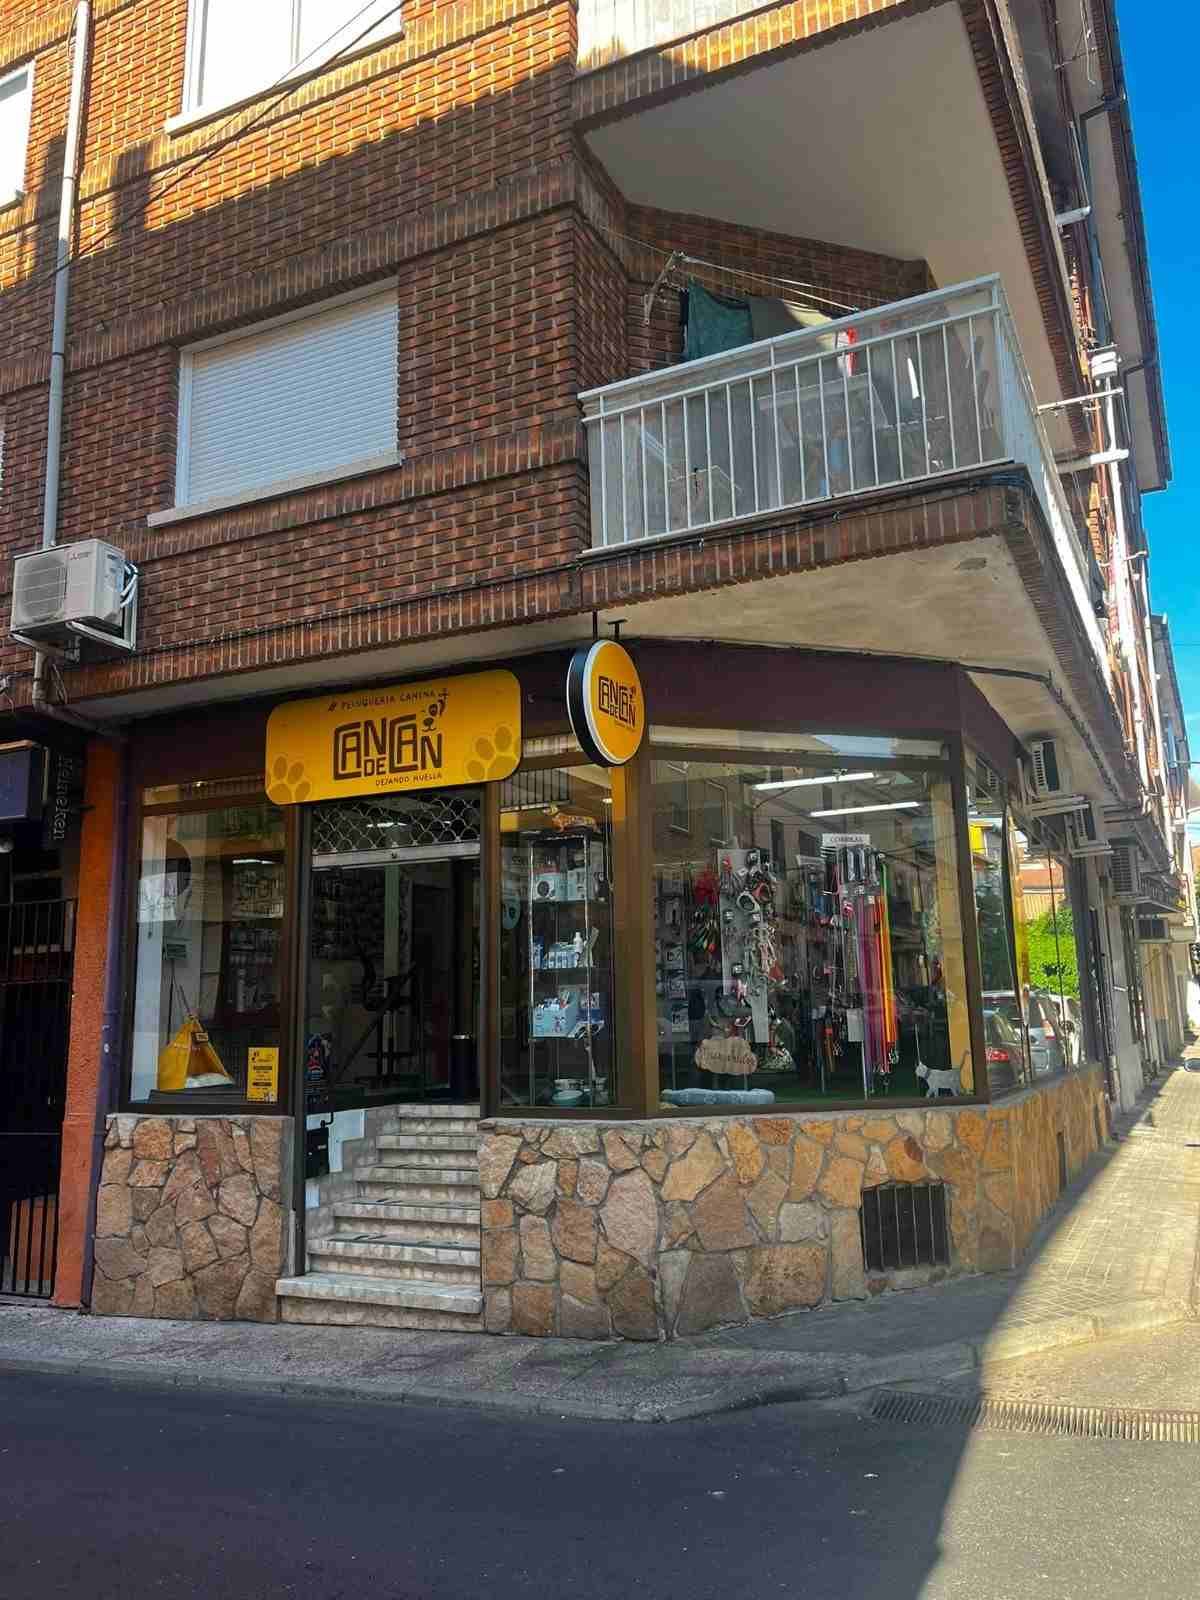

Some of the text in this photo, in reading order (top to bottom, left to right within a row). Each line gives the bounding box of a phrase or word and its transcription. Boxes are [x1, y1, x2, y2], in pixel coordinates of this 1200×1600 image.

[400, 689, 435, 703] CANINA
[364, 756, 387, 776] DE
[375, 771, 443, 786] DEJANDO HUELLA
